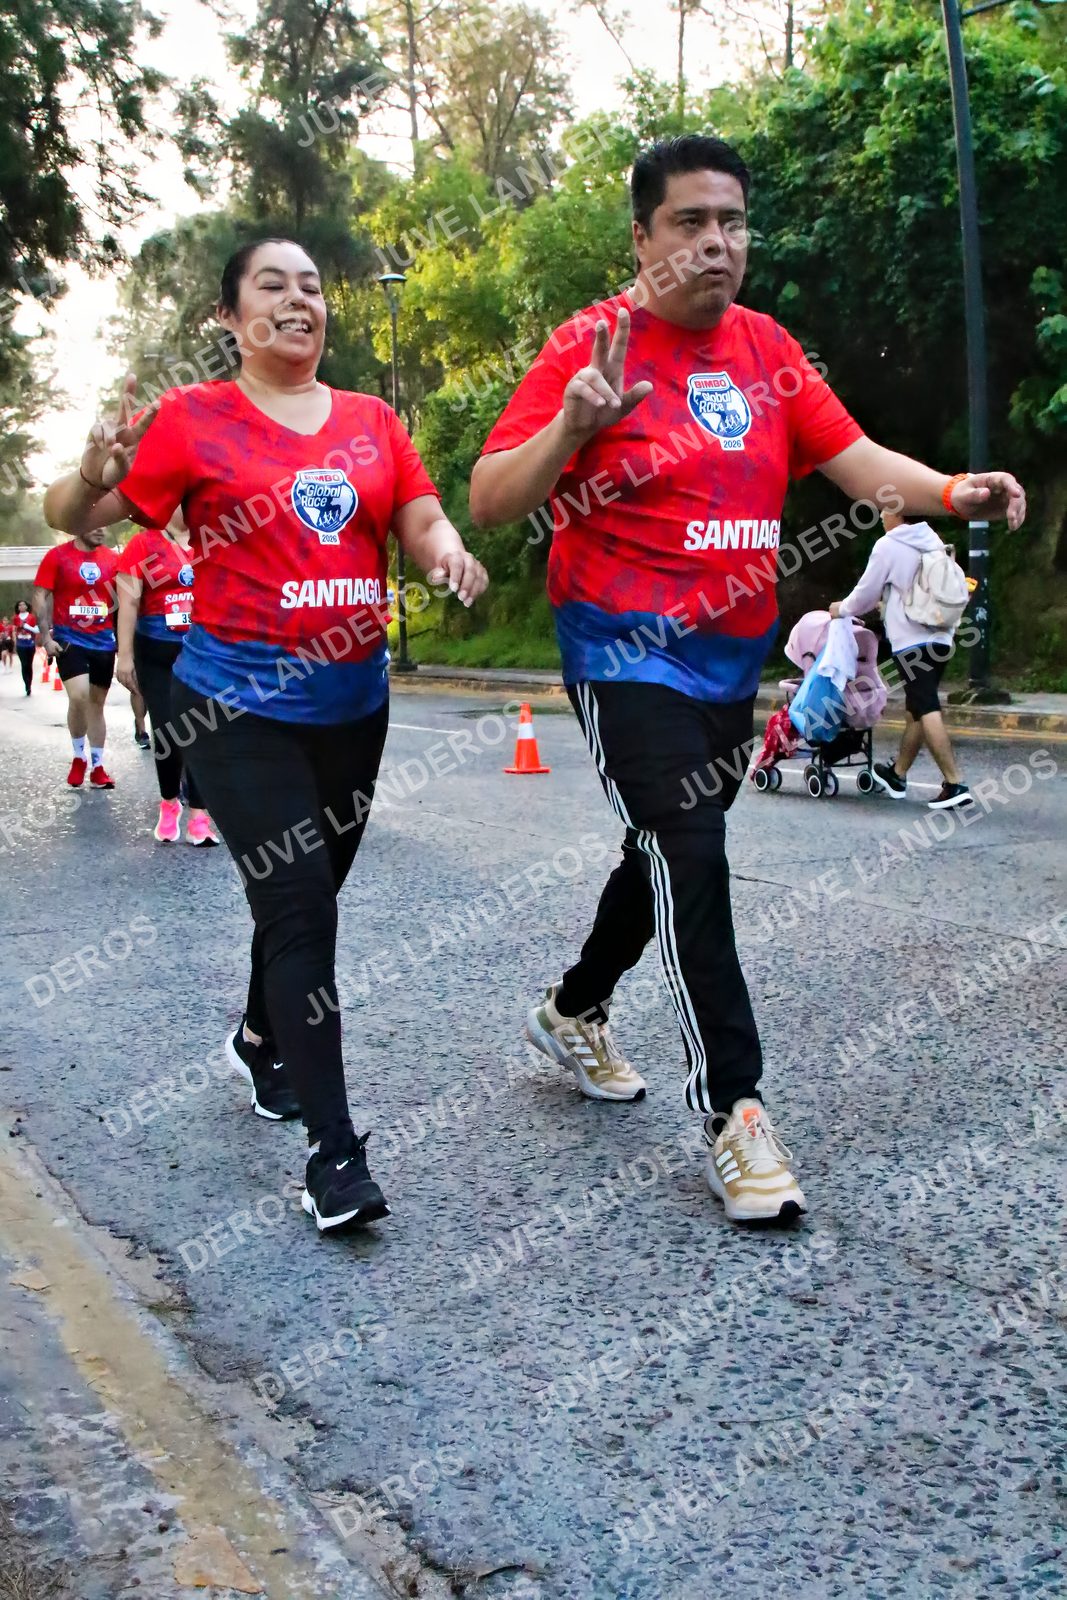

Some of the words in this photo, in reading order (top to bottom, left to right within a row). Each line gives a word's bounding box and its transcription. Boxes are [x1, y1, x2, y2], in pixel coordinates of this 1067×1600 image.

[694, 379, 727, 389] BIMBO
[699, 400, 725, 413] Race
[723, 439, 742, 448] 2026
[306, 484, 341, 498] Global
[301, 496, 327, 507] Race
[322, 534, 338, 543] 2026
[280, 577, 381, 609] SANTIAGO
